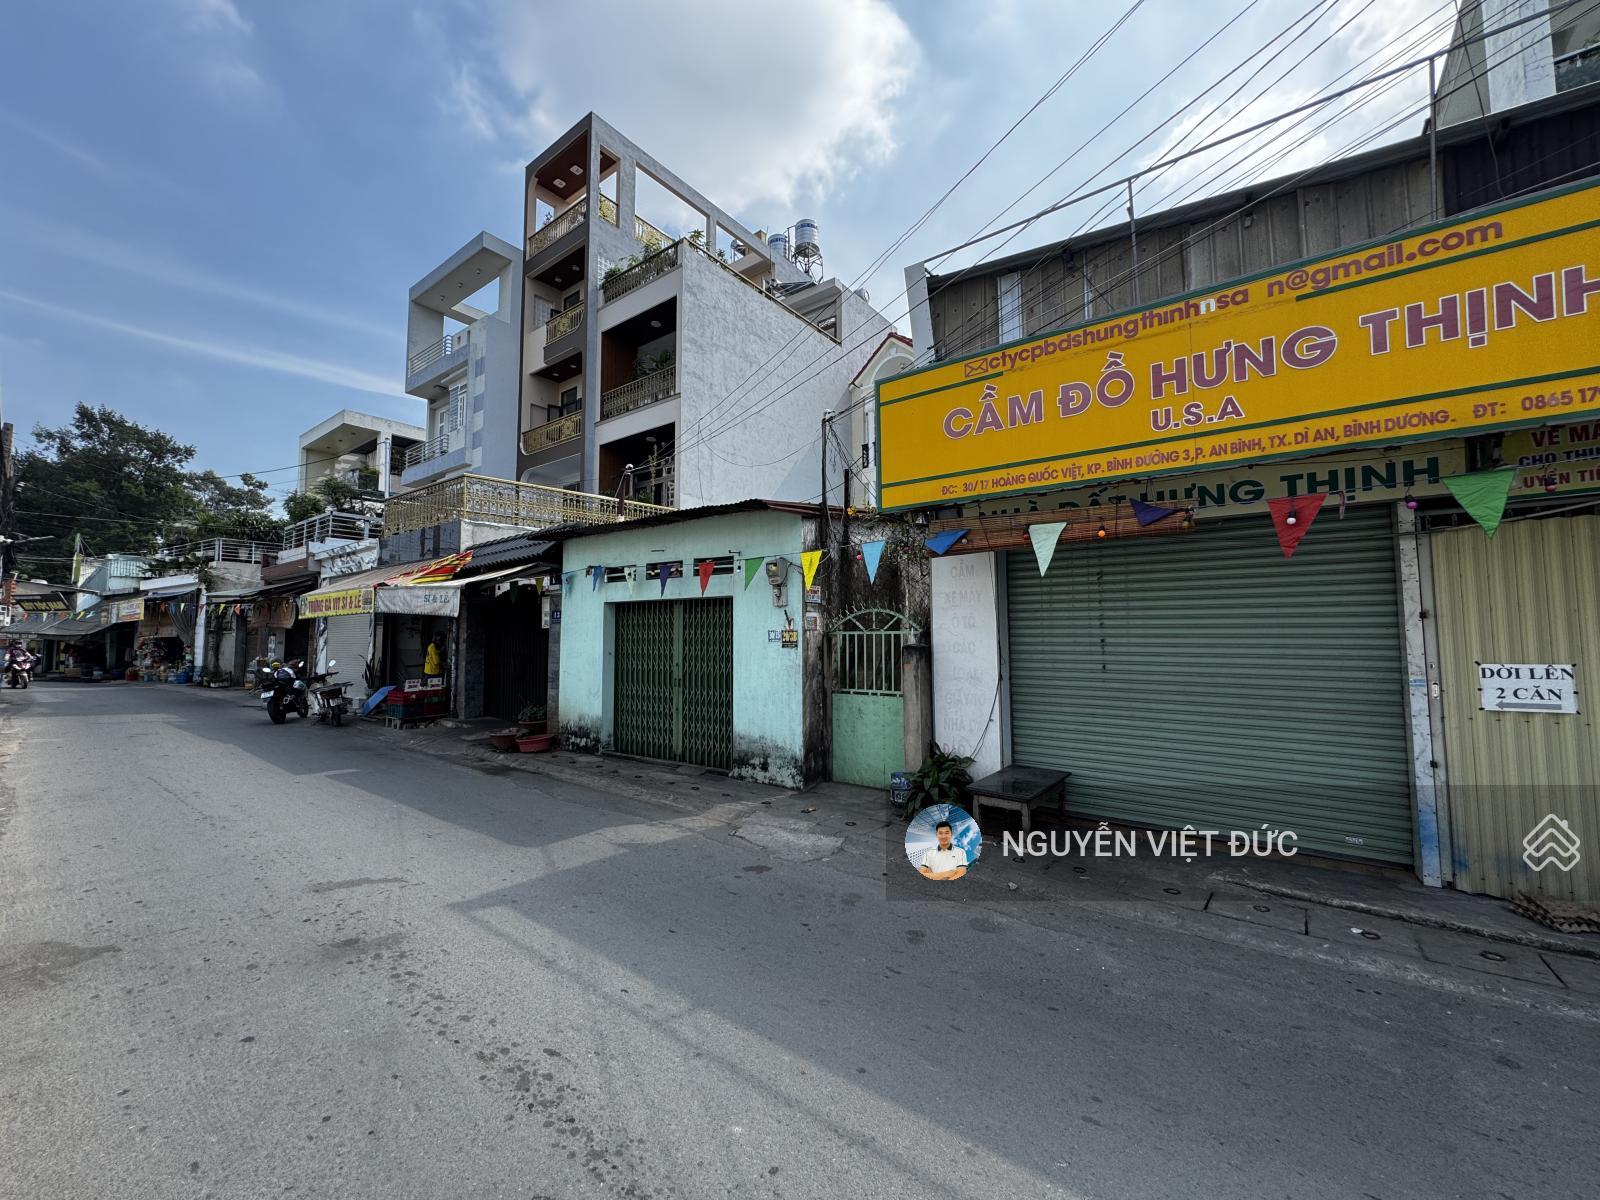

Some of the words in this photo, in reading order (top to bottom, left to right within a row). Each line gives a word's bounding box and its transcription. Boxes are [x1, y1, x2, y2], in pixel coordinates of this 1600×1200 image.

[943, 383, 1045, 439] CẦM
[1057, 351, 1135, 418] ĐỒ
[1150, 326, 1338, 399] HƯNG
[1359, 265, 1600, 355] THỊNH
[1151, 396, 1245, 432] U.S.A
[991, 472, 1026, 488] HOÀNG
[1028, 466, 1058, 483] QUỐC
[1087, 463, 1105, 475] KP.
[1107, 457, 1132, 473] BÌNH
[1209, 443, 1228, 457] AN
[1230, 437, 1266, 455] BÌNH,
[1313, 427, 1340, 442] AN,
[1344, 417, 1381, 438] BÌNH
[1473, 402, 1507, 419] ĐT:
[1521, 390, 1573, 411] 0865
[1279, 457, 1440, 502] THỊNH
[1480, 664, 1521, 680] DỜI
[1528, 664, 1574, 680] LÊN
[1496, 687, 1506, 699] 2
[1513, 685, 1563, 700] CĂN
